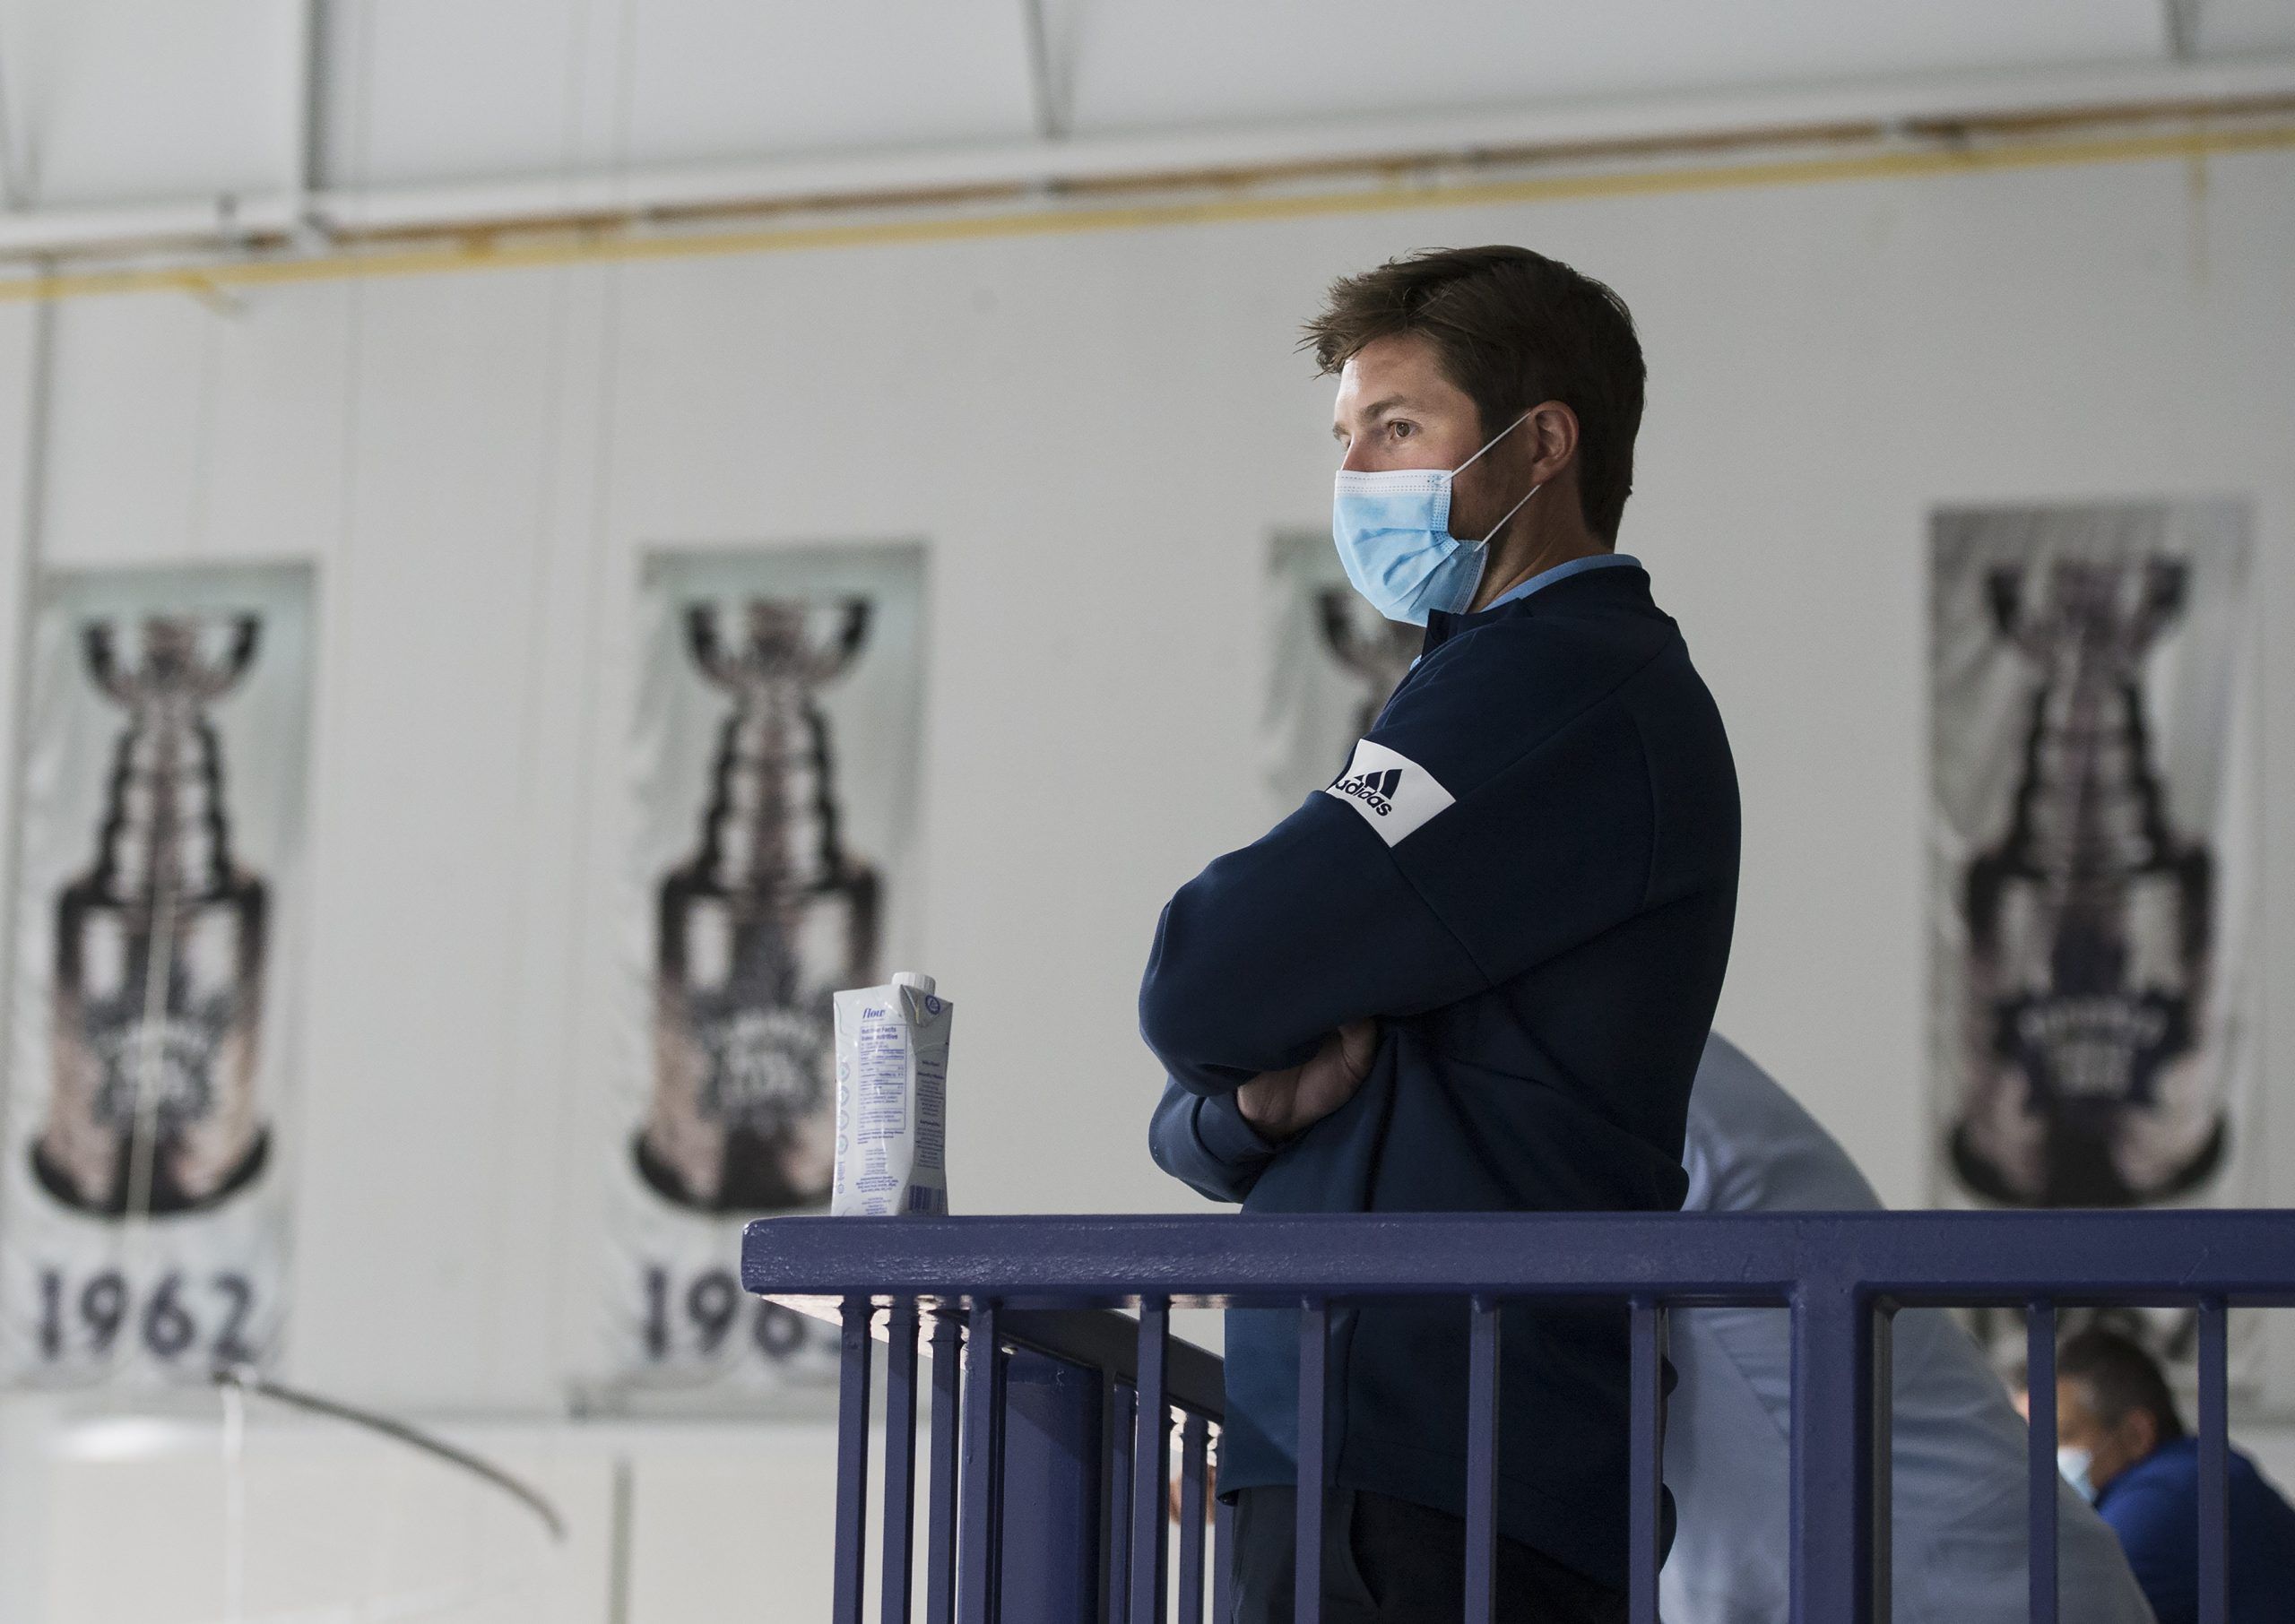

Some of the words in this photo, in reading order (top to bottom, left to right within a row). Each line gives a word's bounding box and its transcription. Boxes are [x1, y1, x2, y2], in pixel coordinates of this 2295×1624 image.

[862, 1007, 886, 1019] flow
[37, 1266, 258, 1363] 1962
[641, 1262, 841, 1361] 196
